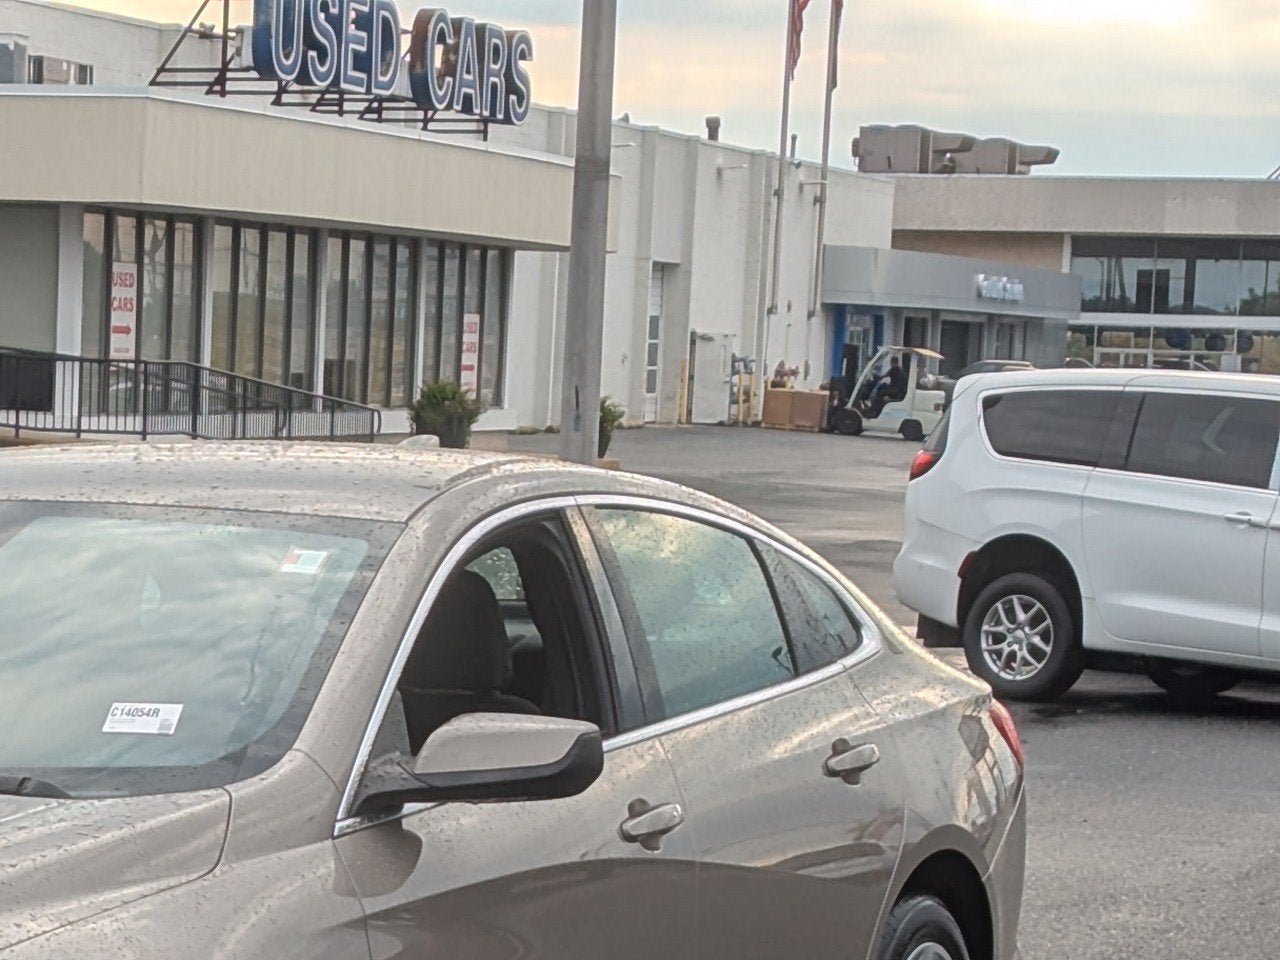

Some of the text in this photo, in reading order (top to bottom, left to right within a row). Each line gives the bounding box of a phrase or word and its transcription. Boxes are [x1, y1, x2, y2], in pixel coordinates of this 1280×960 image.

[258, 0, 533, 125] USED CARS
[111, 272, 135, 288] USED
[111, 296, 134, 313] CARS
